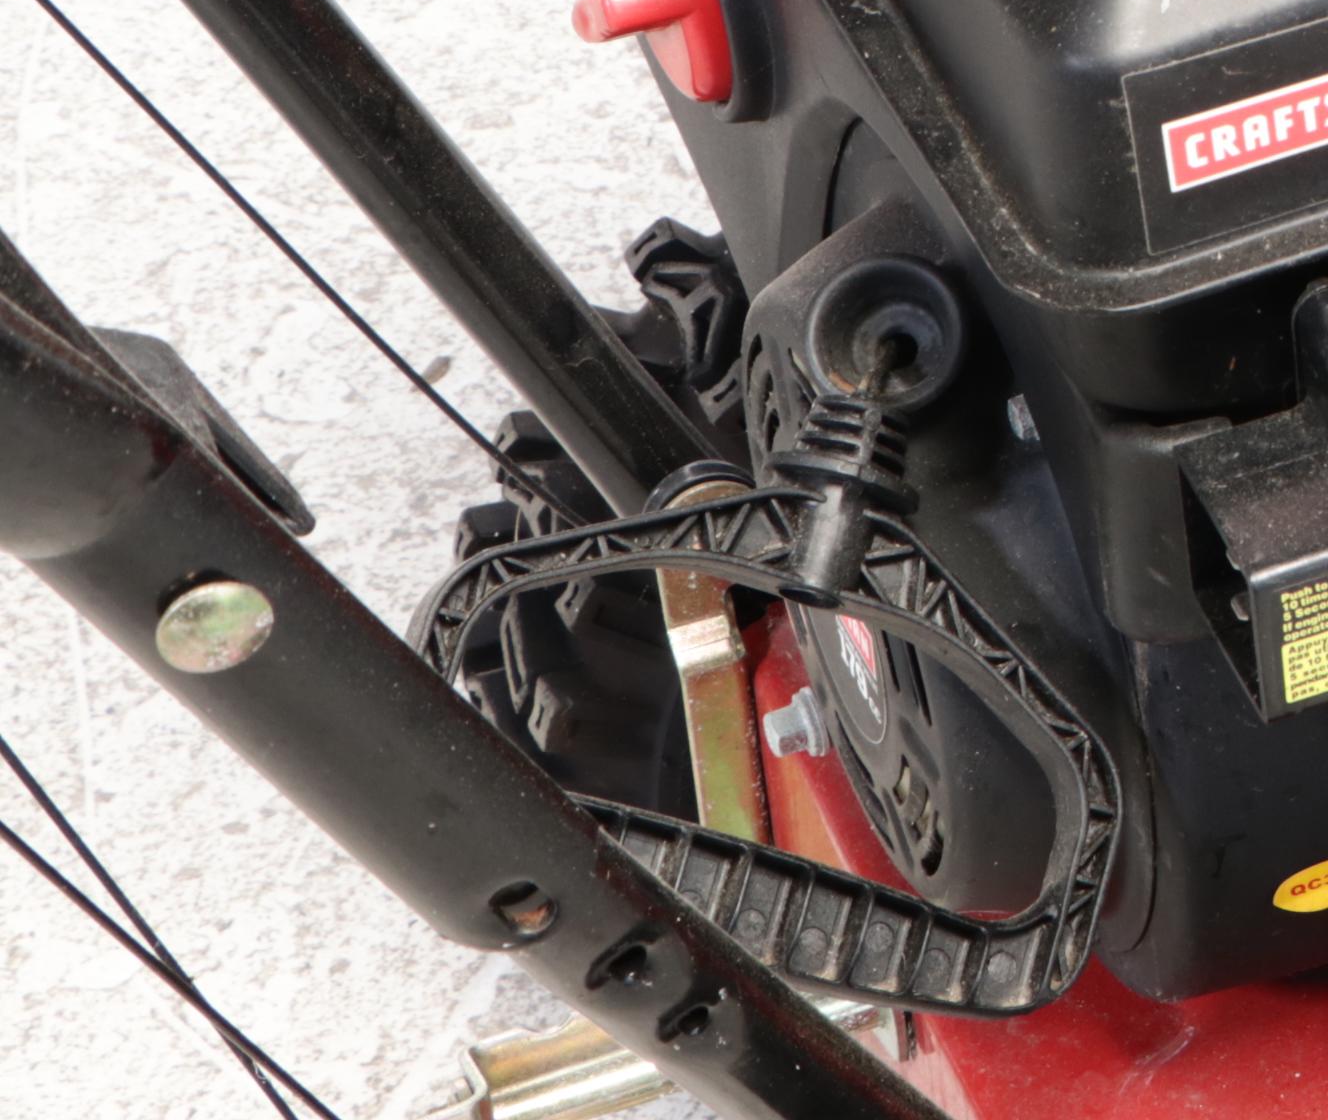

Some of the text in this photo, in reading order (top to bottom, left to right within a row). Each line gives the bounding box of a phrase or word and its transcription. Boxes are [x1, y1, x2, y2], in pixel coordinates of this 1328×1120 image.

[1280, 584, 1312, 603] Push
[1314, 579, 1328, 592] to
[1282, 599, 1298, 612] 10
[1283, 610, 1291, 622] 5
[1282, 621, 1292, 633] If
